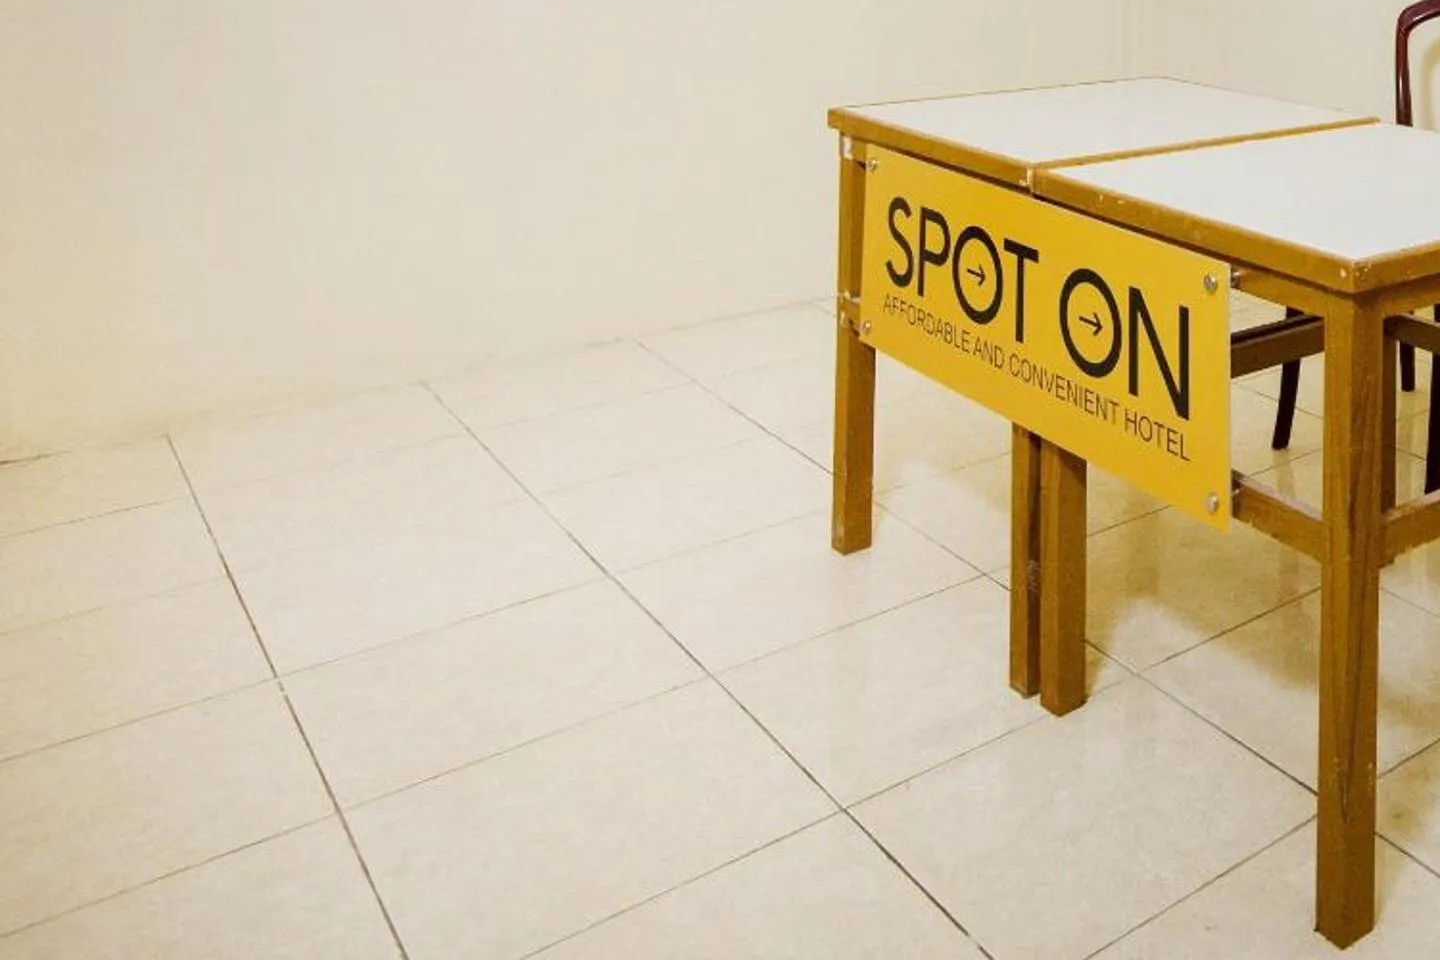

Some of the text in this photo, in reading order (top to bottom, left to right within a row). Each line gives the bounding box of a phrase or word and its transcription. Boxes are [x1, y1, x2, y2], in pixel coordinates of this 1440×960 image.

[882, 293, 1190, 461] AFFORDABLE AND CONVENIENT HOTEL
[885, 196, 1190, 421] SPOT ON
